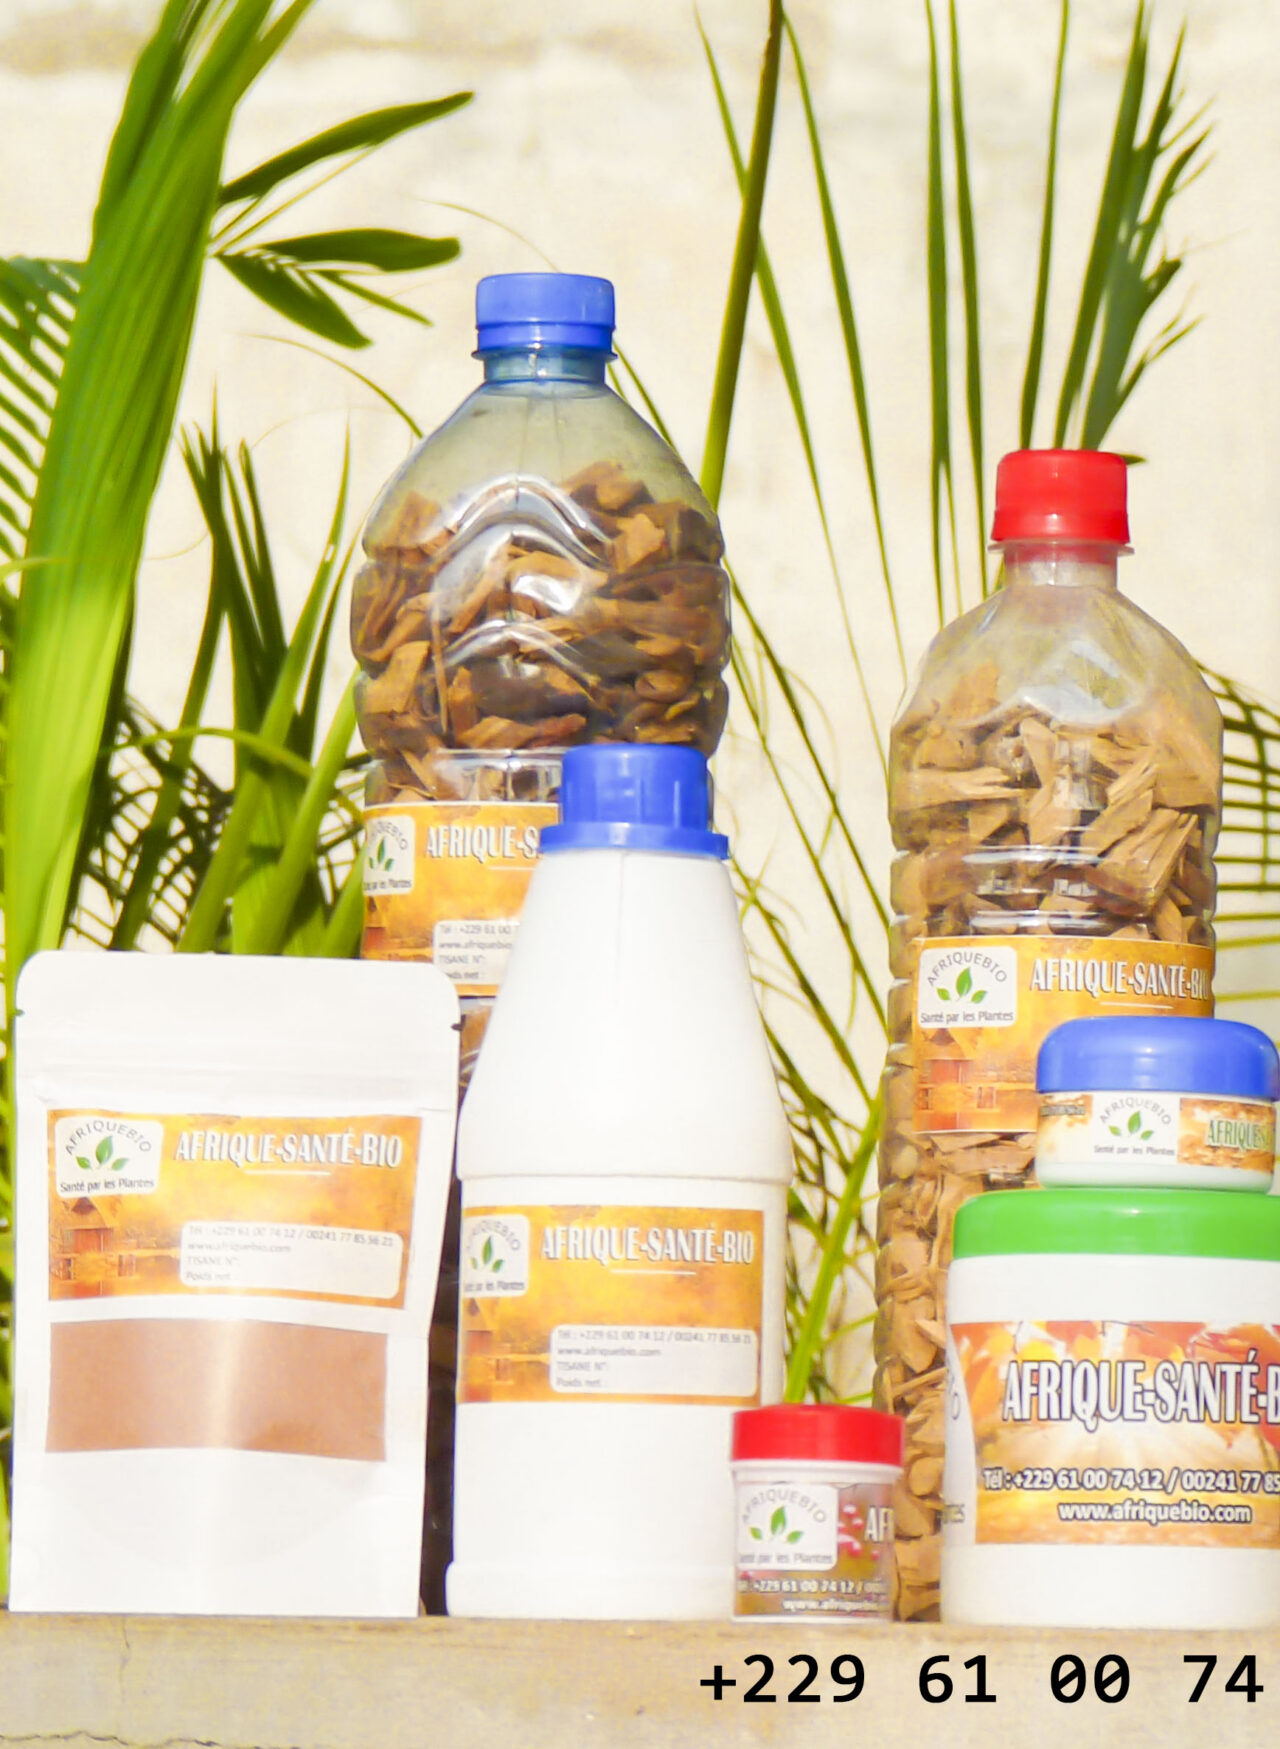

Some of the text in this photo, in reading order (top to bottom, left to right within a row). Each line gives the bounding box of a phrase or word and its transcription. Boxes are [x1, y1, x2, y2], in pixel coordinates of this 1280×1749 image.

[426, 825, 540, 863] AFRIQUE-S
[927, 951, 1007, 987] AFRIQUEBIO
[920, 1010, 1014, 1024] Santé par les Plantes
[1098, 1096, 1172, 1126] AFRIQUEBIO
[65, 1119, 152, 1156] AFRIQUEBIO
[174, 1126, 404, 1169] AFRIQUE-SANTÉ-BIO
[1146, 1146, 1175, 1156] Plantes
[60, 1177, 154, 1193] Santé par les Plantes
[541, 1222, 755, 1267] AFRIQUE-SANTÉ-BIO
[984, 1467, 1003, 1490] Tél
[1013, 1468, 1054, 1490] +229
[1056, 1468, 1079, 1490] 61
[1083, 1469, 1108, 1490] 00
[1111, 1469, 1136, 1490] 74
[1139, 1469, 1165, 1491] 12
[1182, 1470, 1237, 1492] 00241
[1240, 1471, 1262, 1493] 77
[1058, 1498, 1252, 1527] www.afriquebio.com
